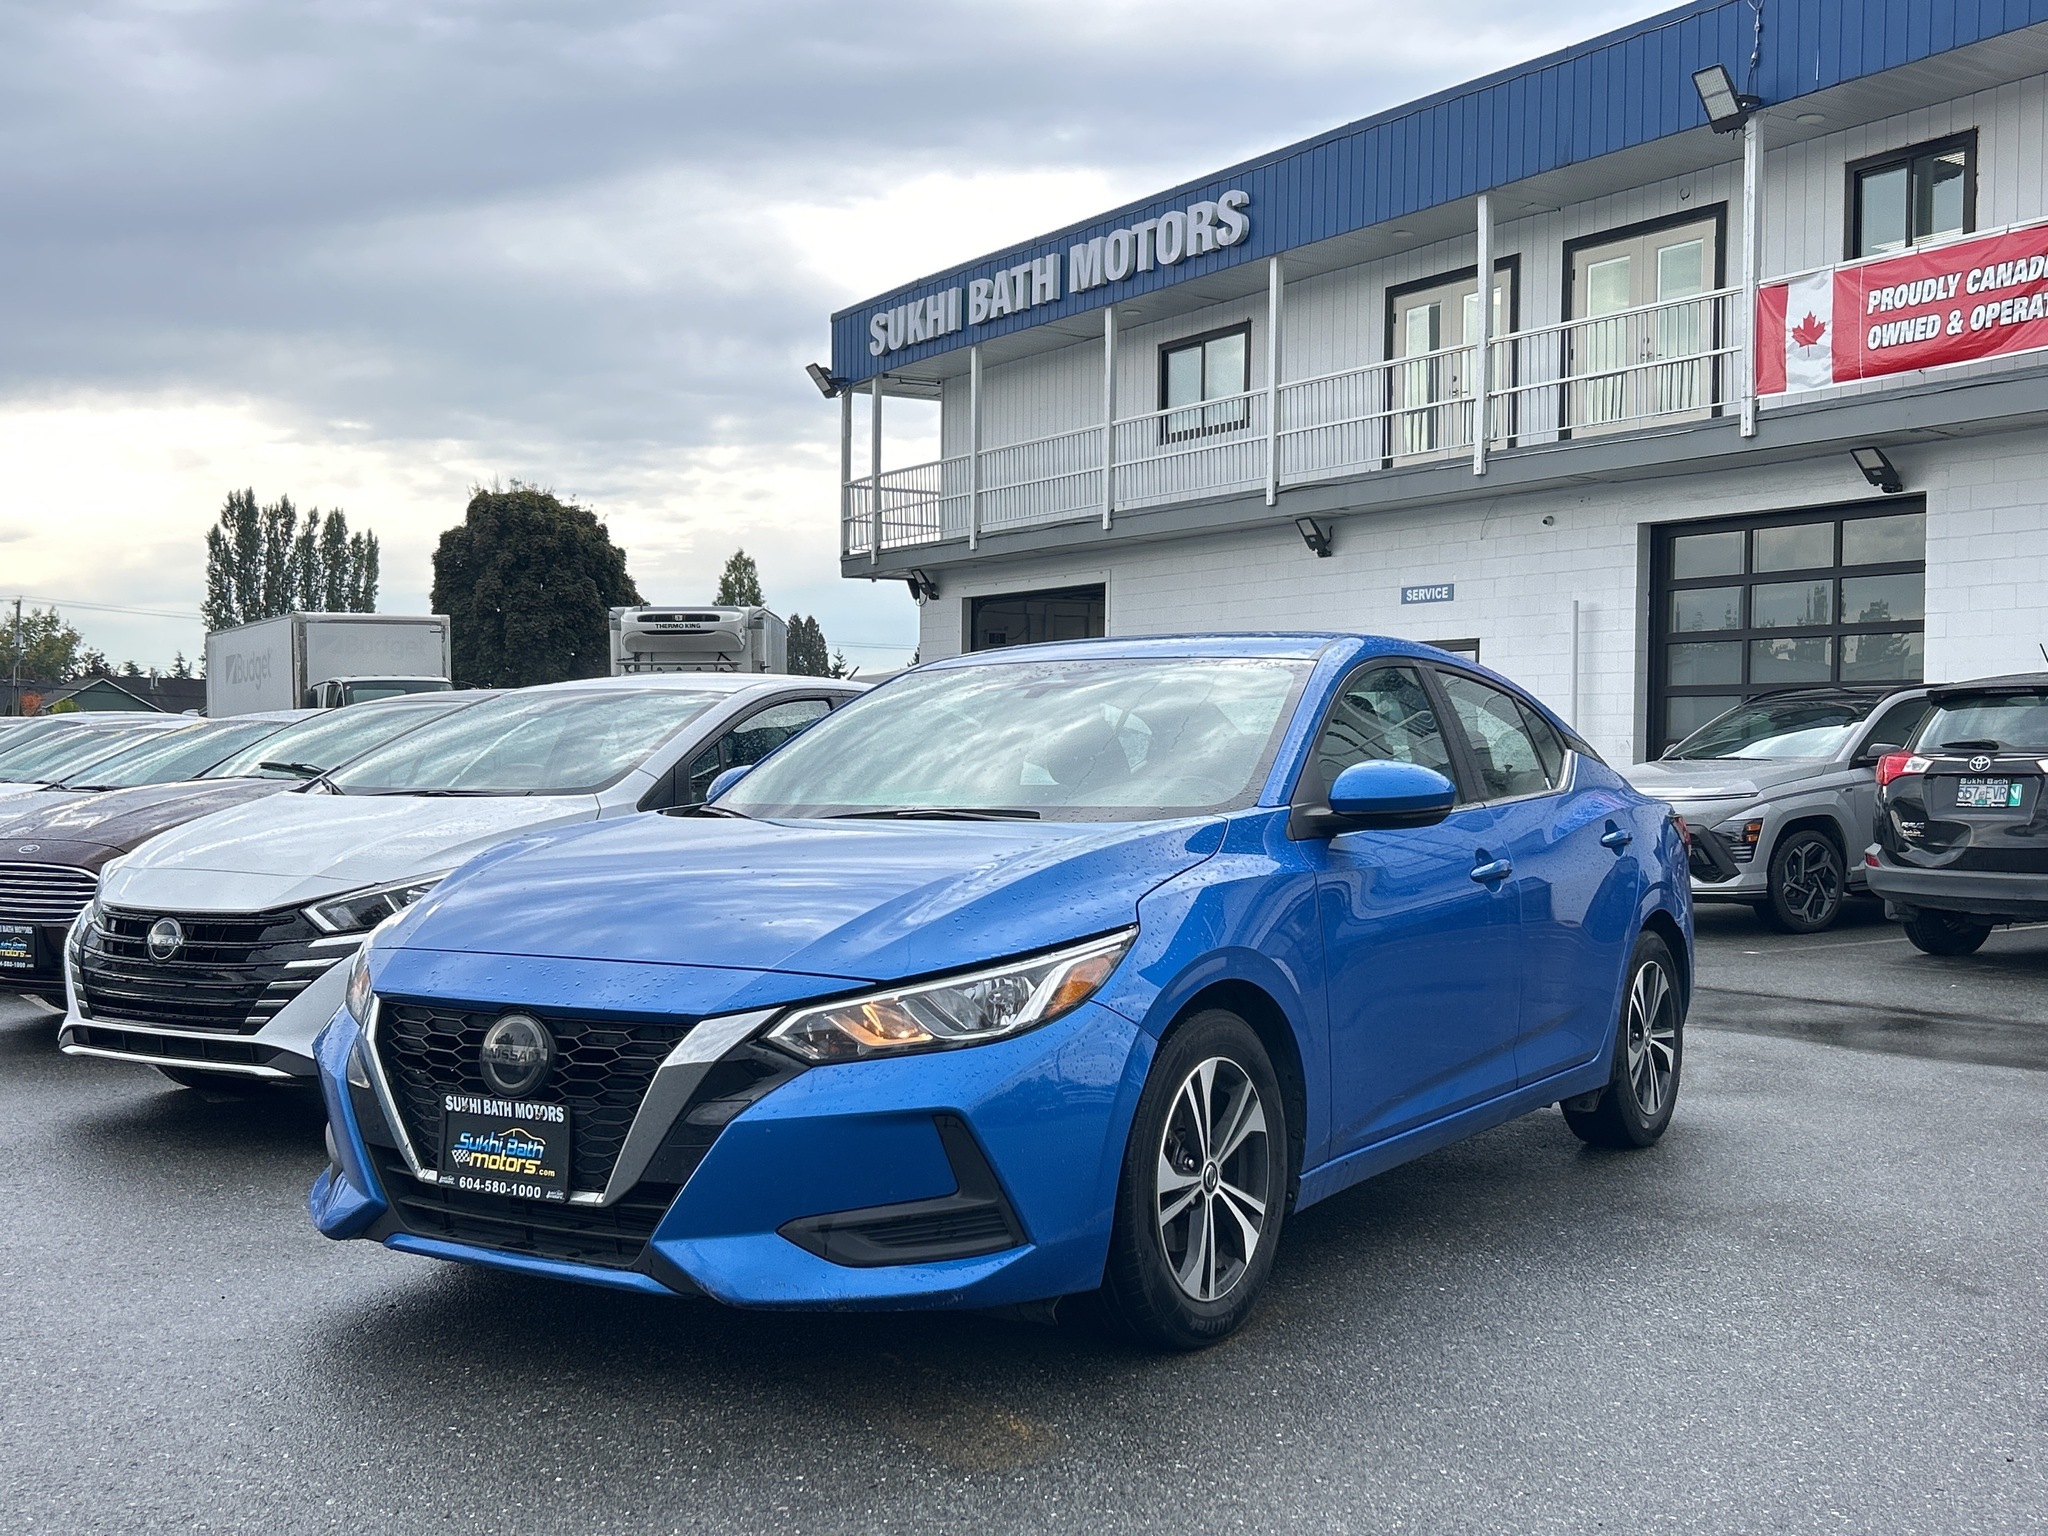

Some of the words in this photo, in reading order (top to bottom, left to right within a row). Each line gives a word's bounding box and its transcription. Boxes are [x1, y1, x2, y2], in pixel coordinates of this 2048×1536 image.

[869, 287, 963, 356] SUKHI
[969, 253, 1061, 326] BATH
[1069, 189, 1250, 294] MOTORS
[1866, 271, 1962, 315] PROUDLY
[1867, 314, 1941, 351] OWNED
[1947, 309, 1964, 336] &
[1406, 586, 1449, 601] SERVICE
[236, 648, 272, 690] Budget
[1986, 786, 2007, 800] EVR
[445, 1095, 481, 1114] SUKHI
[483, 1099, 512, 1118] BATH
[515, 1102, 564, 1123] MOTORS
[454, 1131, 503, 1153] Sukhi
[506, 1138, 544, 1158] Bath
[459, 1176, 541, 1198] 604-580-1000
